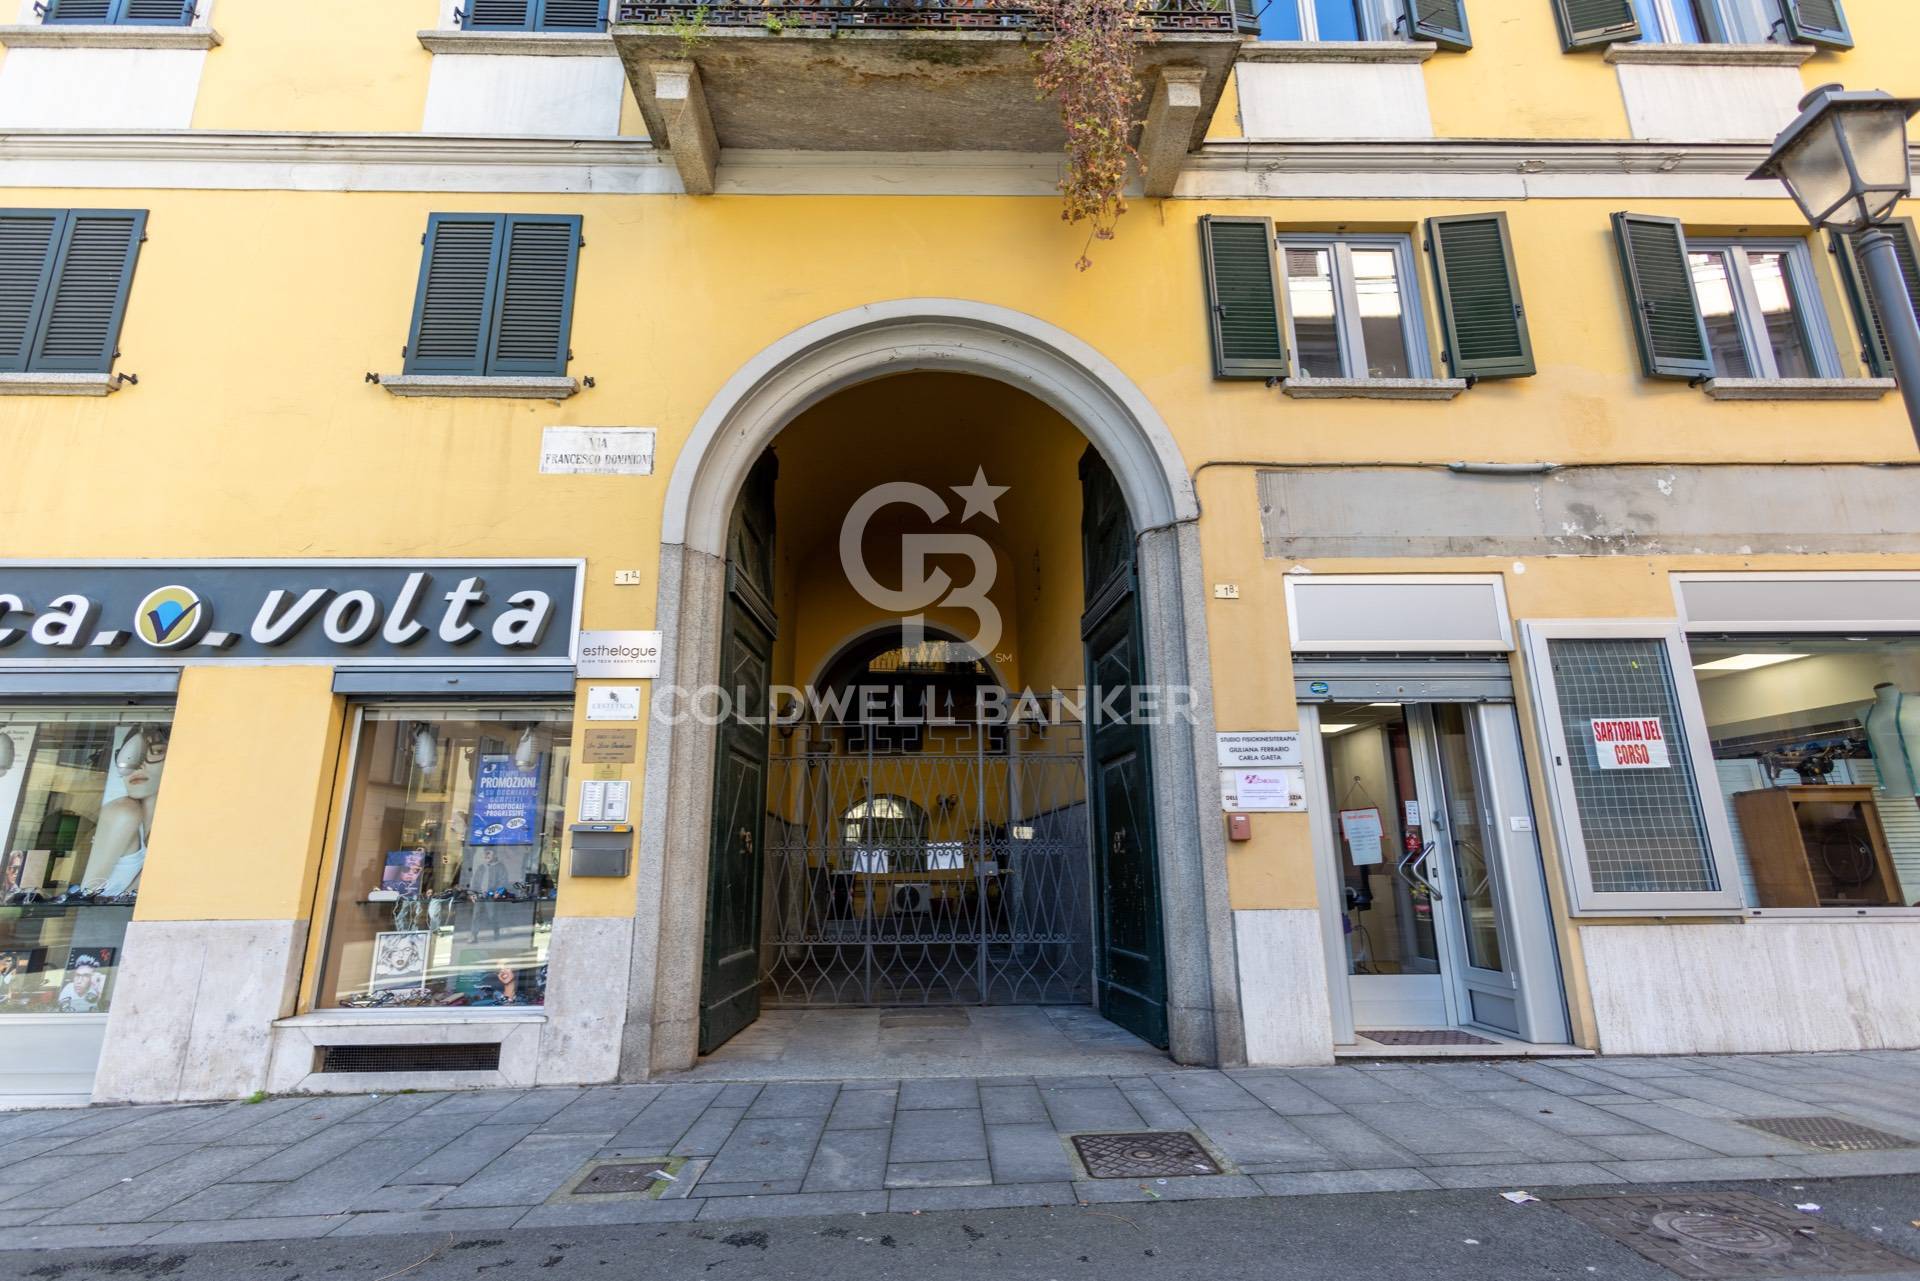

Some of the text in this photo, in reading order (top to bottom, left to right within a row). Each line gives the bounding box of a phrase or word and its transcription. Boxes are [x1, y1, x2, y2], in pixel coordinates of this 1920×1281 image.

[588, 437, 608, 449] VIA
[545, 453, 601, 465] FRANCESCO
[250, 571, 551, 647] volta
[582, 644, 657, 659] esthelogue
[1593, 720, 1662, 742] SARTORIA DEL
[1260, 745, 1290, 753] FERRARIO
[1614, 743, 1650, 765] CORSO
[480, 776, 537, 789] PROMOZIONI
